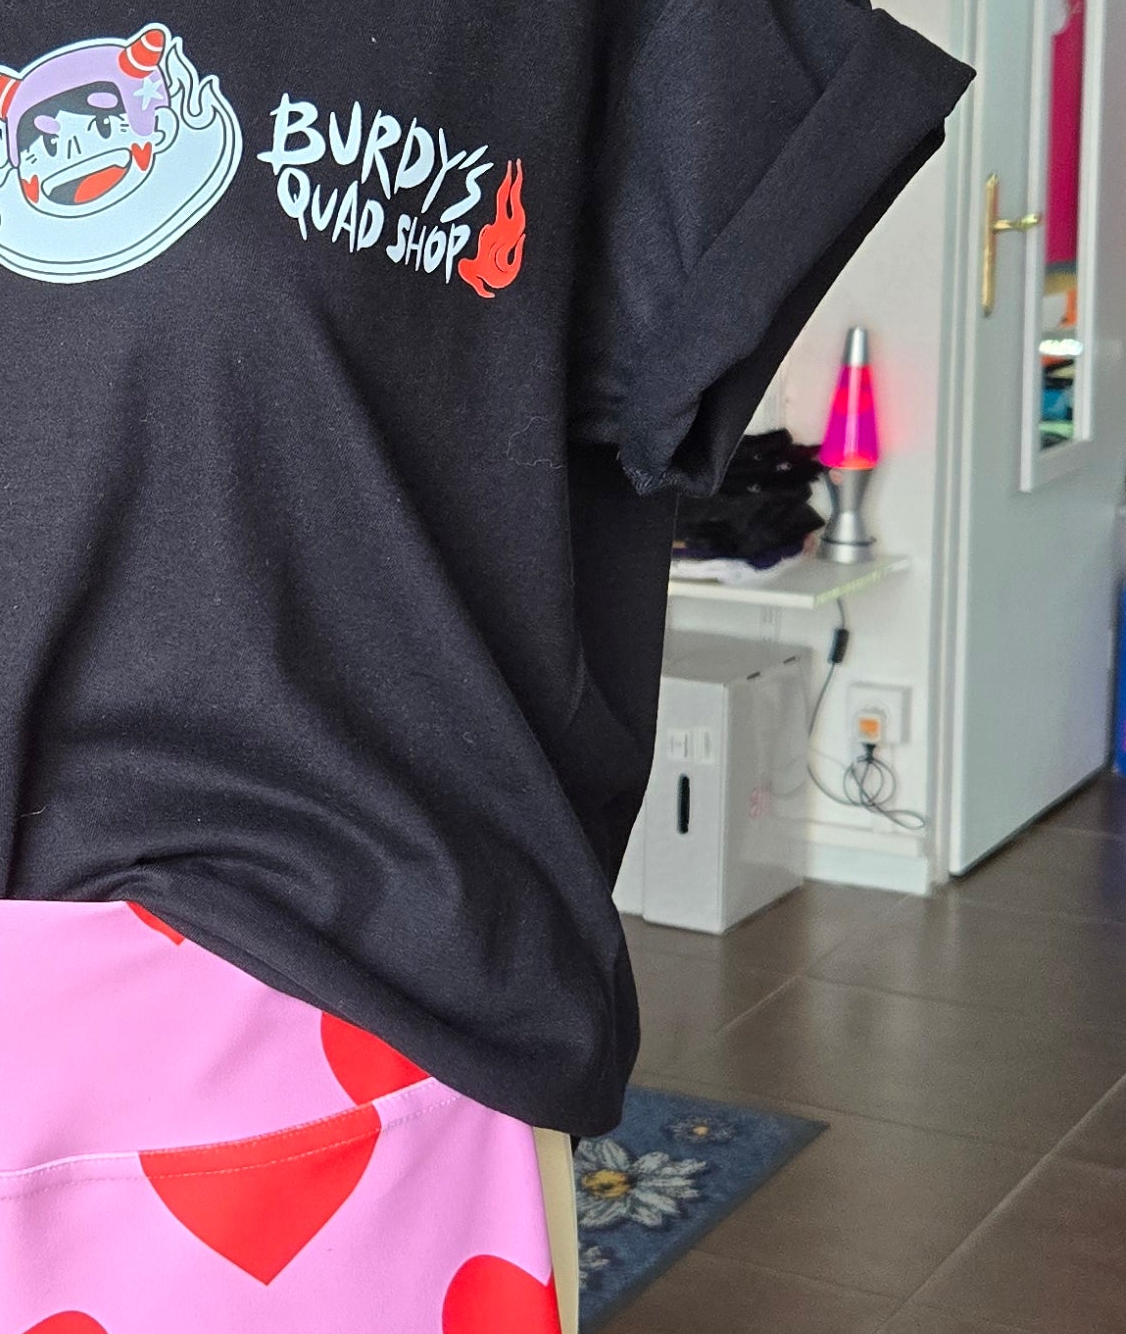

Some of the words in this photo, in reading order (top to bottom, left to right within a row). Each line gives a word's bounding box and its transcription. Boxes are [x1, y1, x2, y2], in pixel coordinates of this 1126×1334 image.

[257, 93, 494, 223] BURDY'S
[276, 167, 385, 253] QUAD
[386, 214, 471, 284] SHOP
